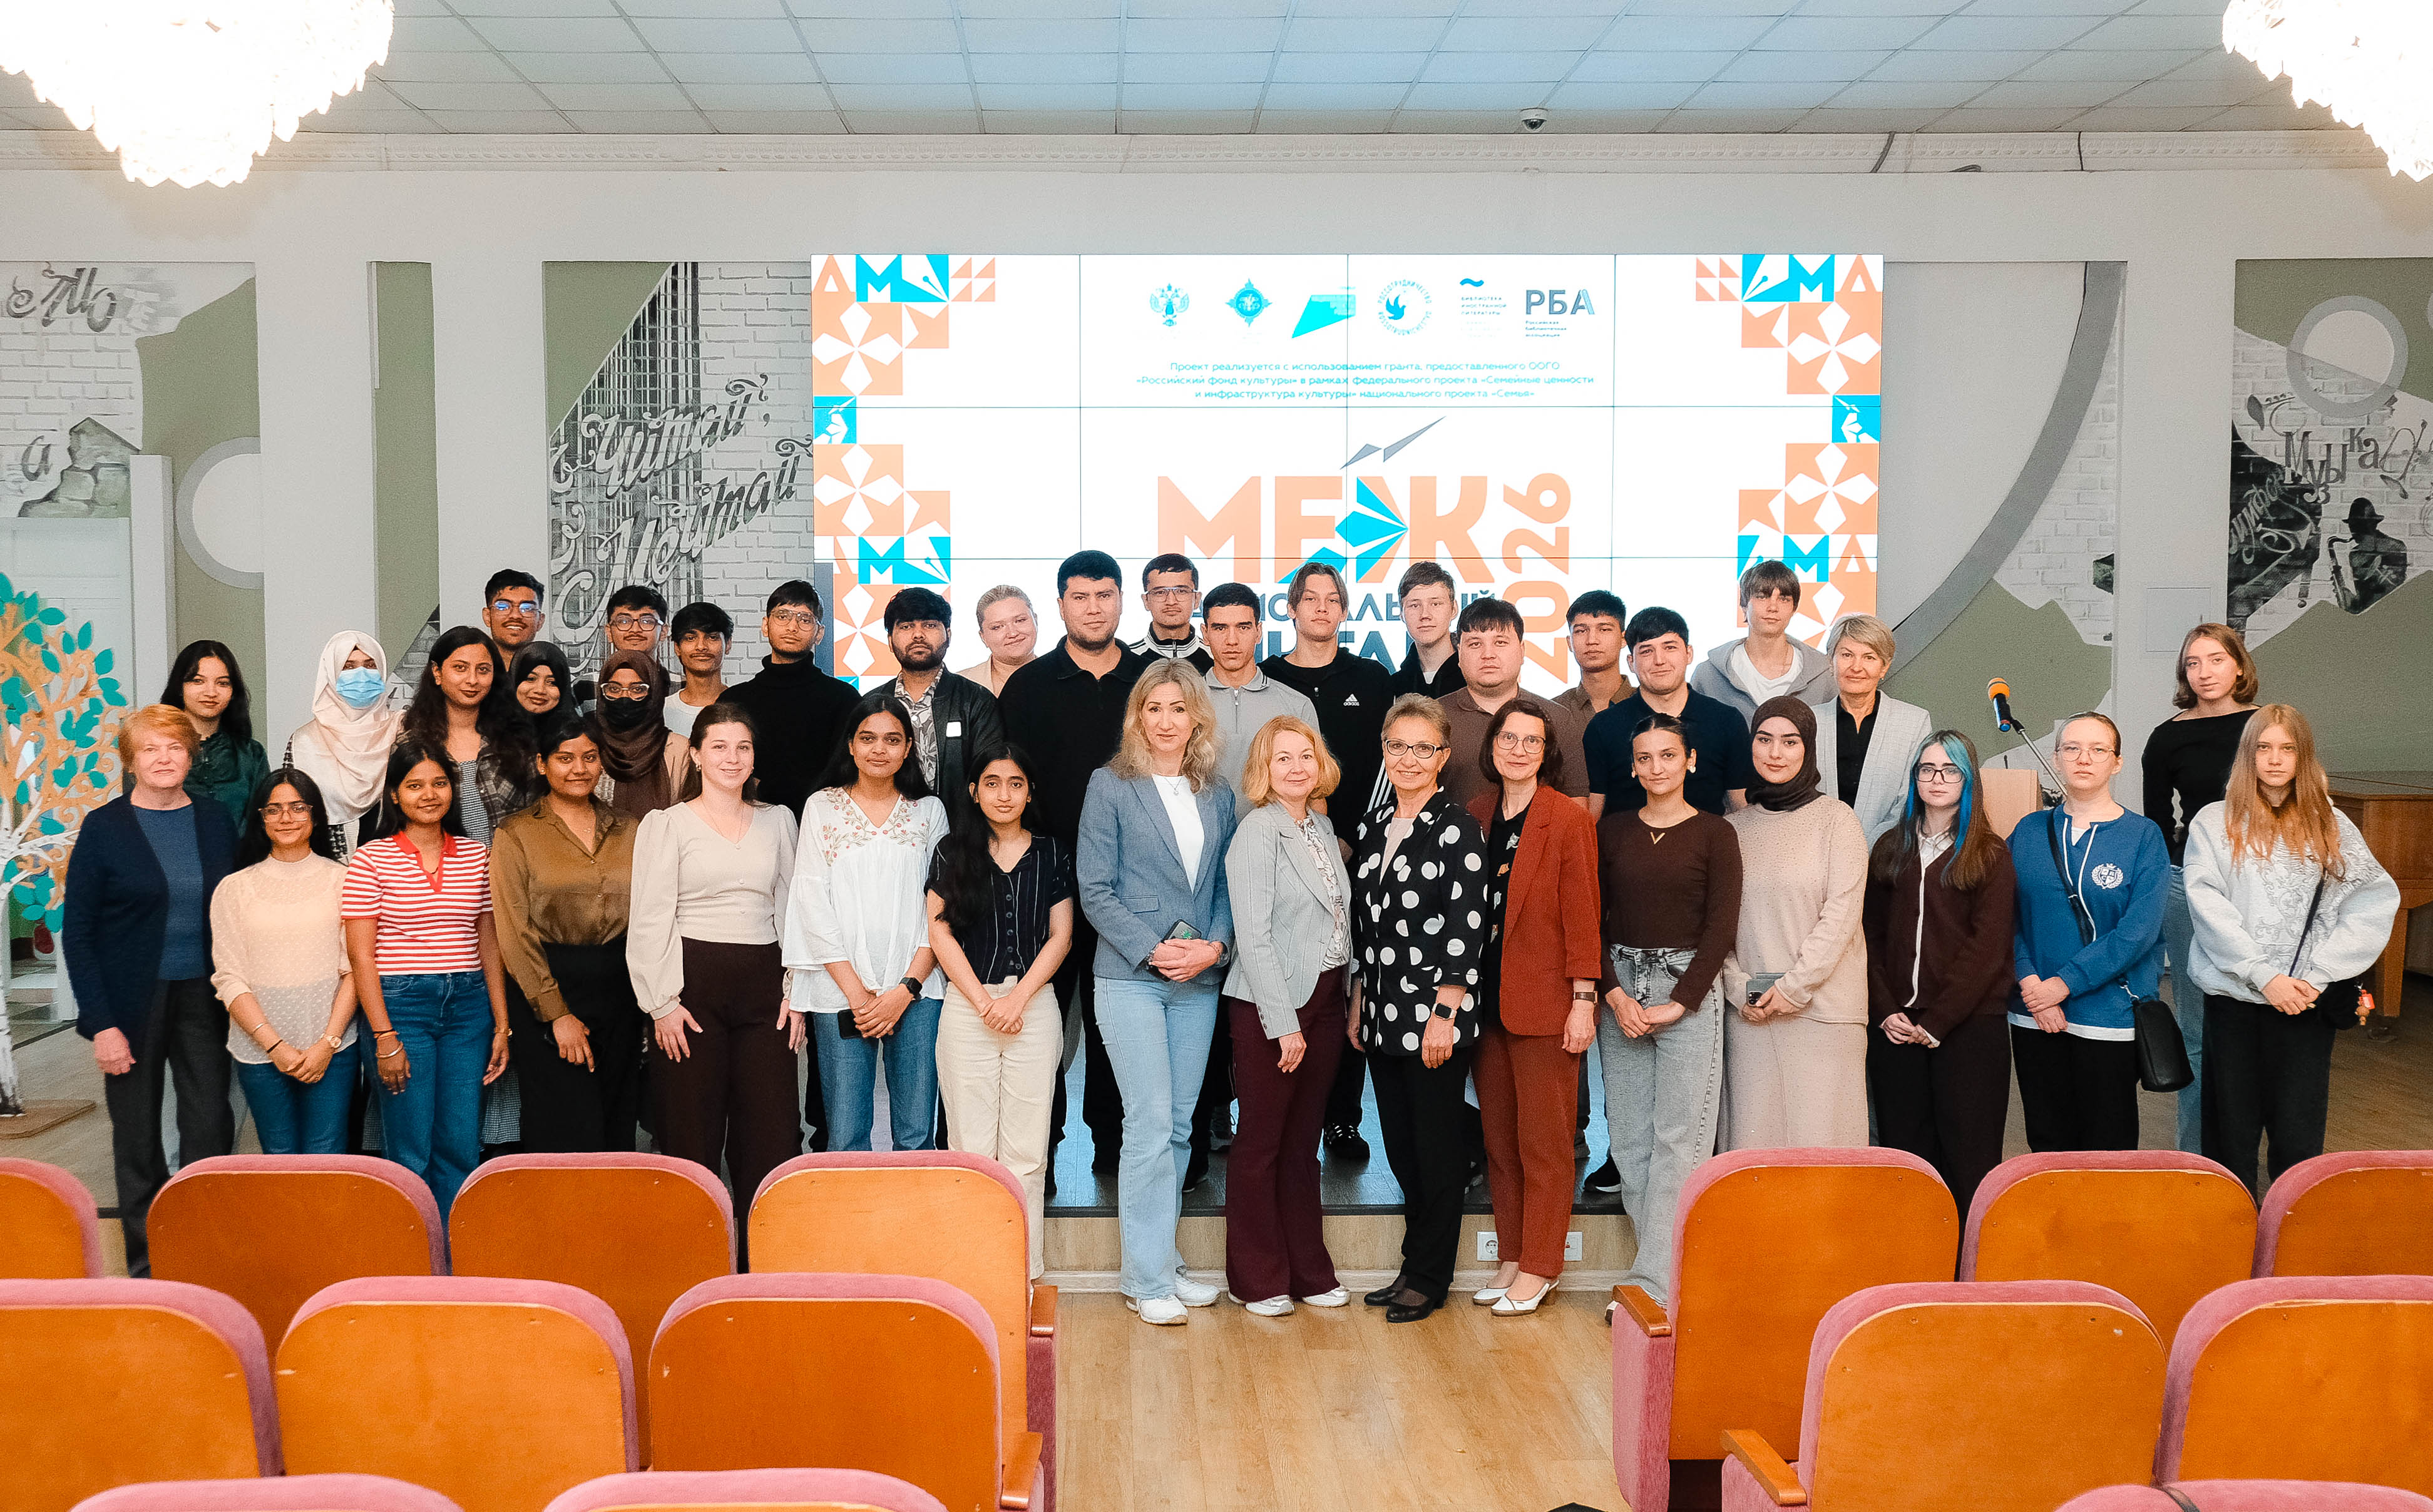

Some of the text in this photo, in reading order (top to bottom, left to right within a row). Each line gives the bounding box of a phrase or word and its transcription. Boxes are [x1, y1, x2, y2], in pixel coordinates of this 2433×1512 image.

[1525, 289, 1595, 315] РБА
[1170, 362, 1209, 372] Проект
[1212, 364, 1281, 372] реализуется
[1426, 363, 1526, 372] предоставленного
[1528, 362, 1560, 370] ООГО
[1207, 376, 1237, 386] фонд
[1308, 377, 1348, 386] рамках
[1351, 376, 1431, 386] федерального
[1433, 377, 1478, 386] проекта
[1544, 377, 1594, 386] ценности
[1204, 391, 1296, 400] инфраструктура
[1359, 391, 1442, 399] национального
[1444, 391, 1488, 399] проекта
